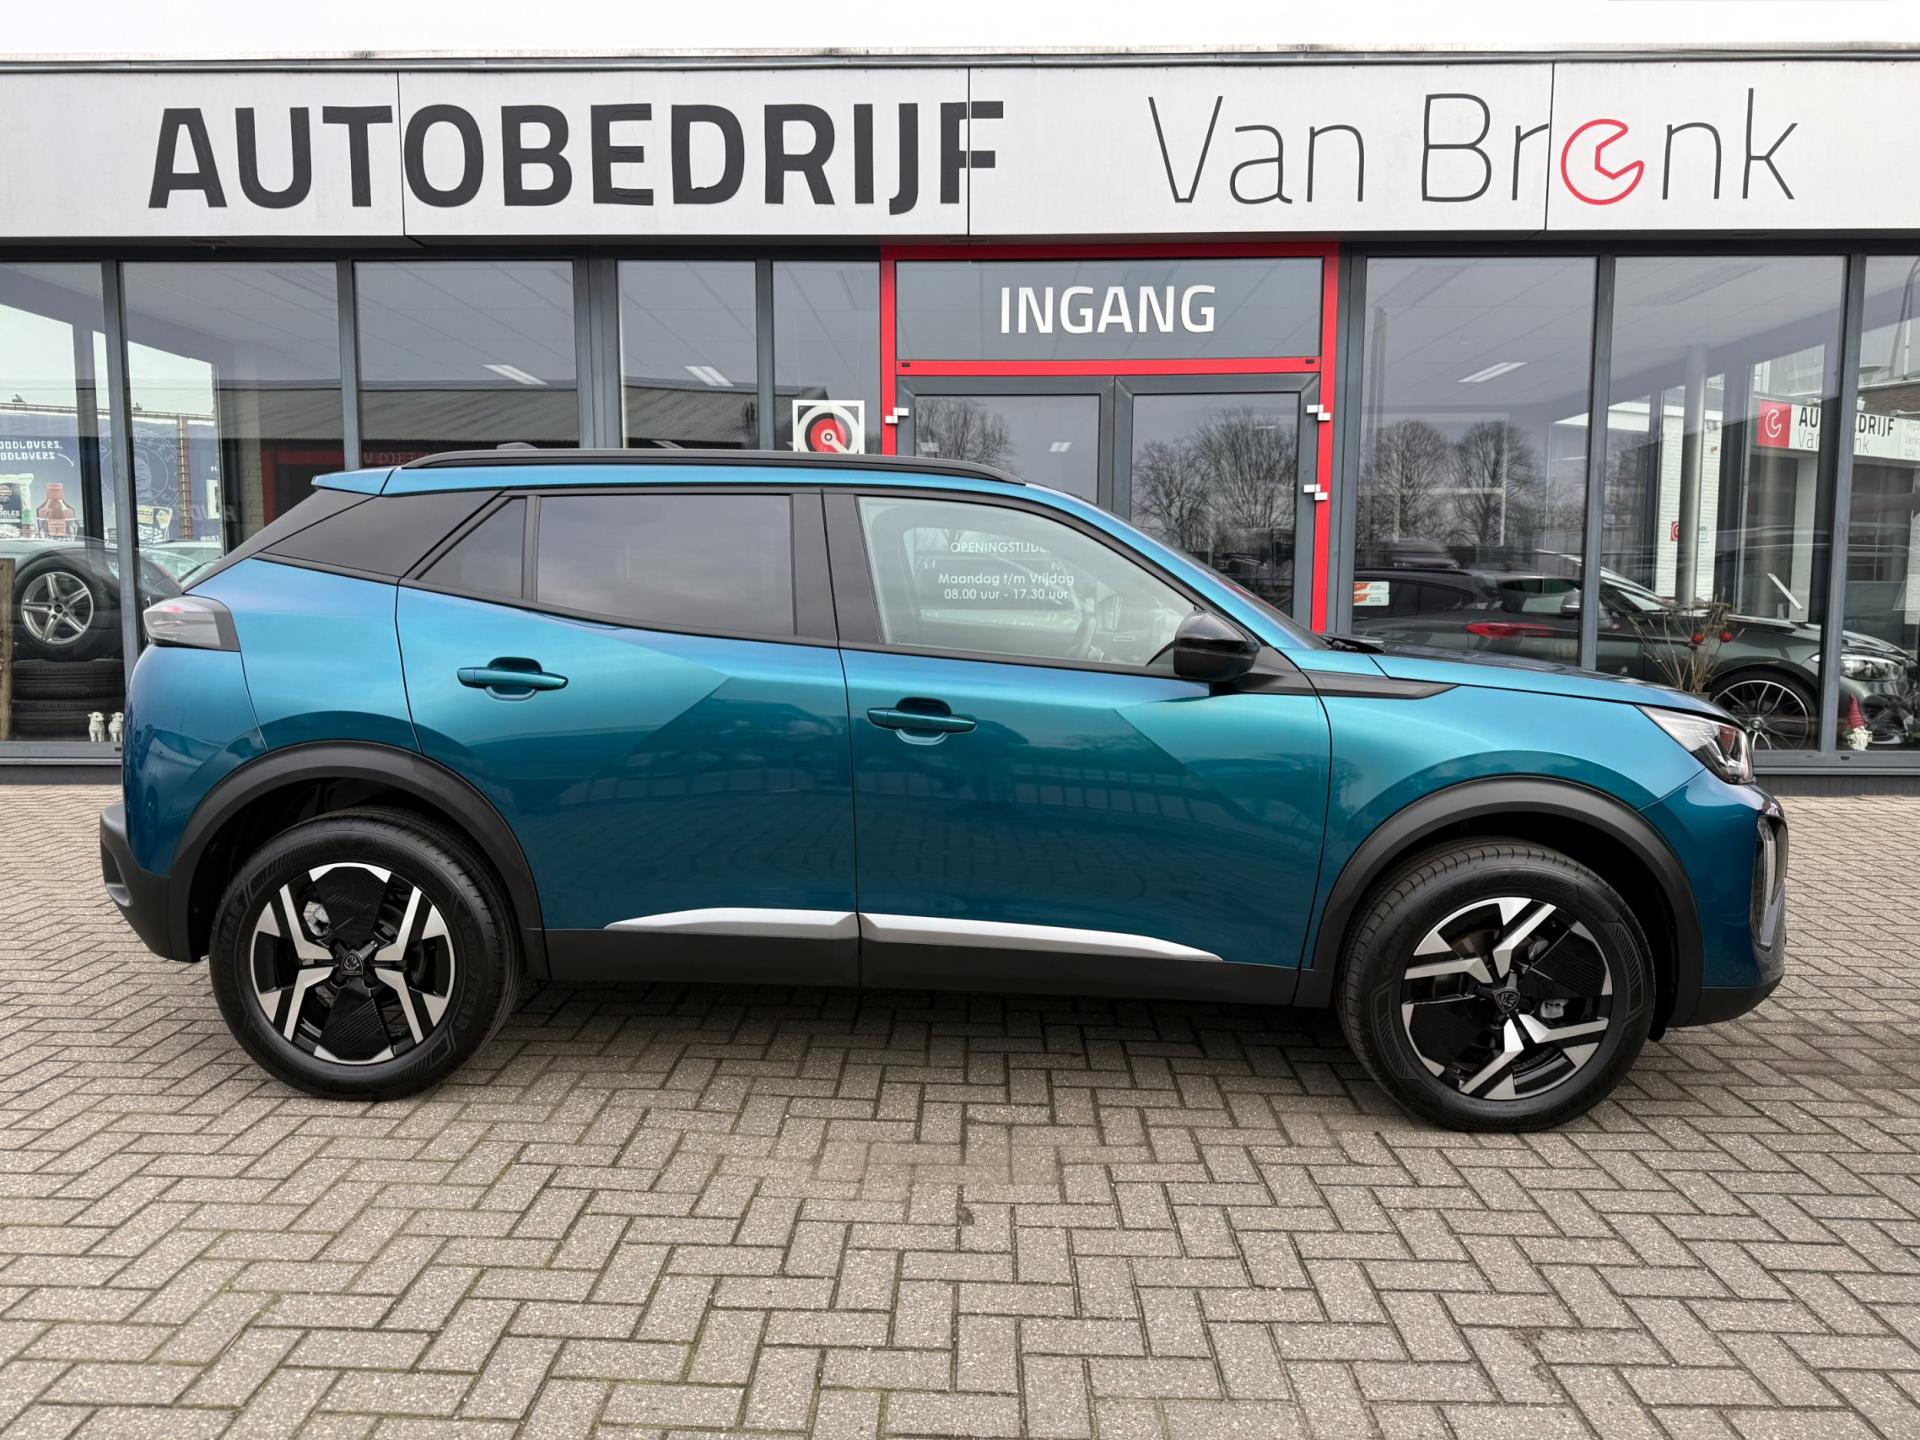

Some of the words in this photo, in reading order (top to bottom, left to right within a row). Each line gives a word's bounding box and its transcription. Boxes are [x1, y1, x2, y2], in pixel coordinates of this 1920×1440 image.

[148, 101, 1004, 216] AUTOBEDRIJF
[1148, 95, 1364, 204] Van
[1000, 285, 1216, 334] INGANG
[938, 573, 1000, 586] Maandag
[1003, 573, 1026, 586] t/m
[1029, 572, 1075, 587] Vrijdag
[944, 588, 977, 600] 08.00
[980, 590, 1000, 600] uur
[1013, 588, 1045, 600] 17.30
[1048, 589, 1069, 600] uur
